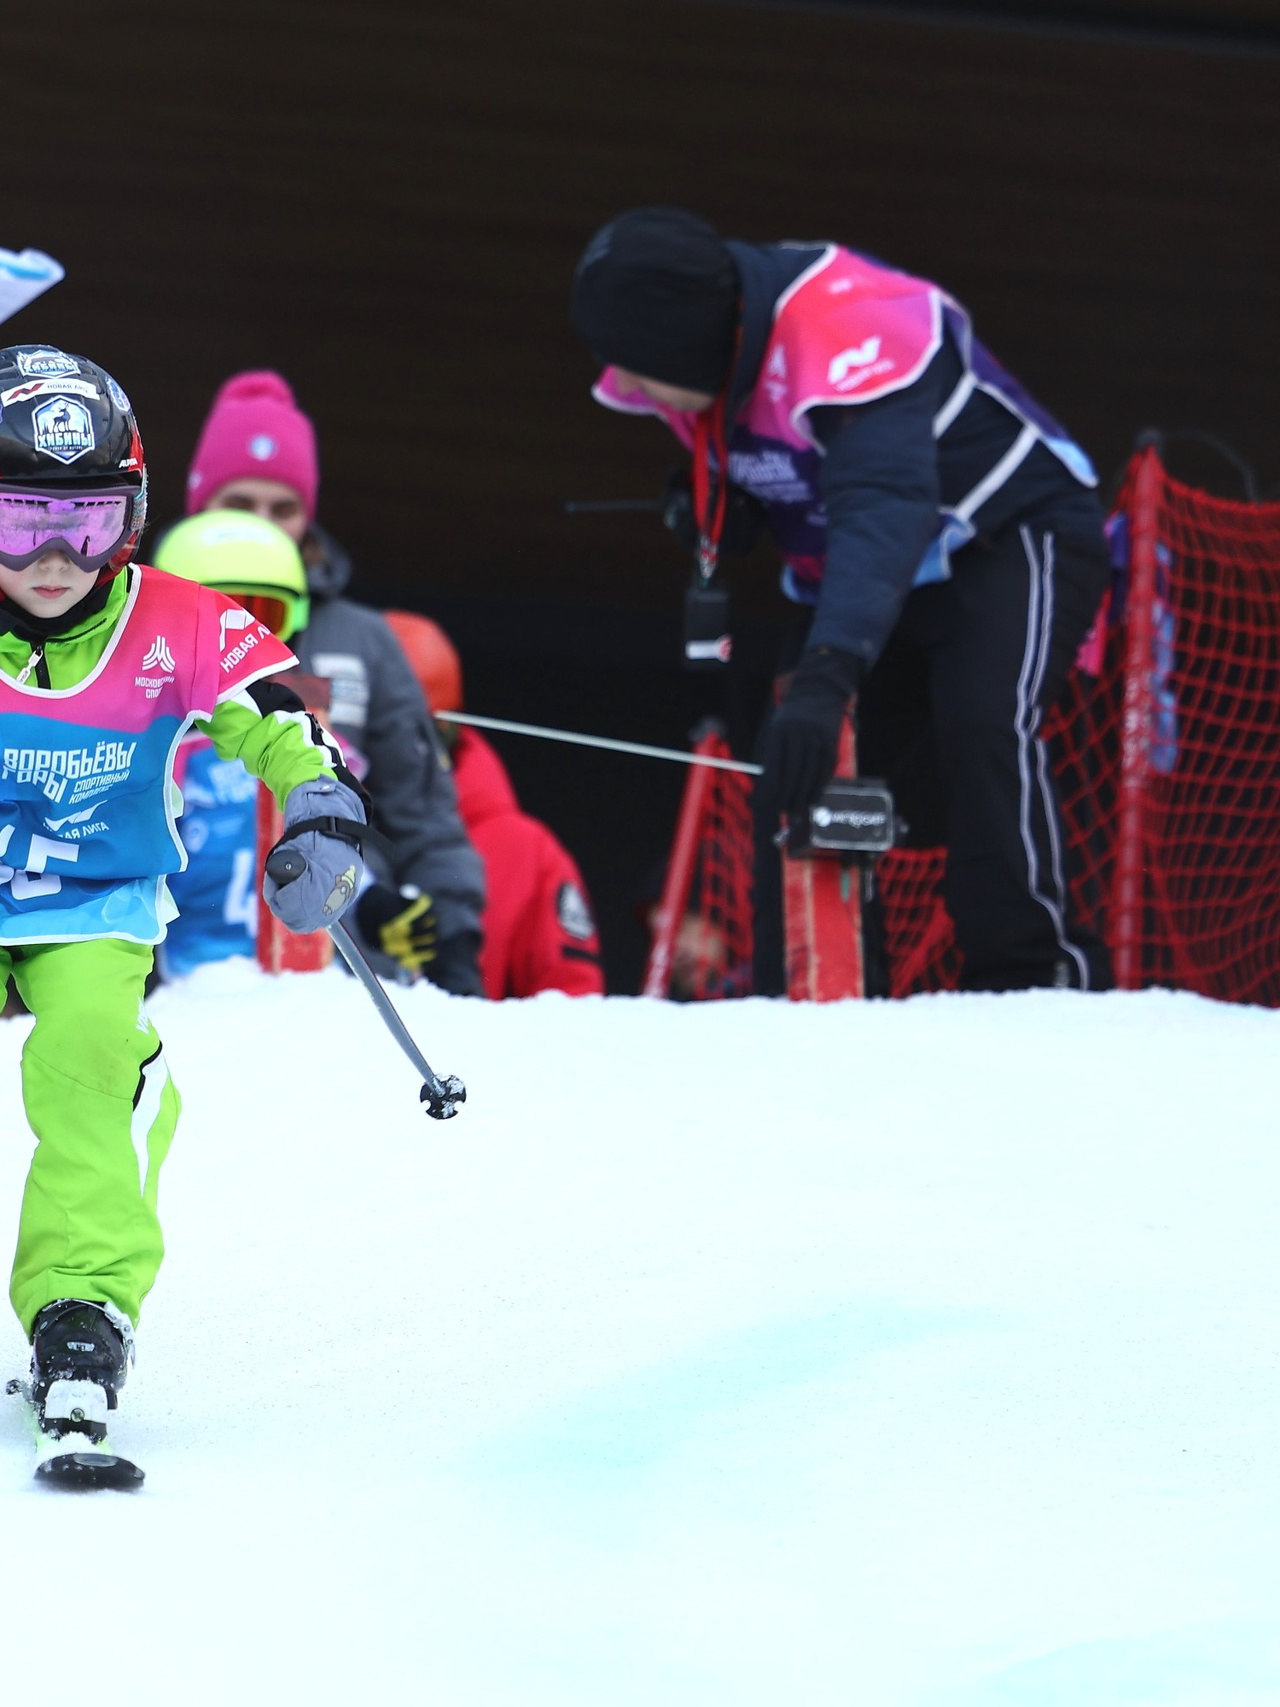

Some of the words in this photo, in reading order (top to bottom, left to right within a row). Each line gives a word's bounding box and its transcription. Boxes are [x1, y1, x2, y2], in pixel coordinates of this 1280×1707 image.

[38, 432, 92, 447] ХИБИНЫ
[220, 633, 258, 674] НОВАЯ
[3, 741, 137, 779] ВОРОБЬЁВЫ
[73, 769, 131, 793] СПОРТИВНЫЙ
[82, 821, 110, 838] ЛИГА
